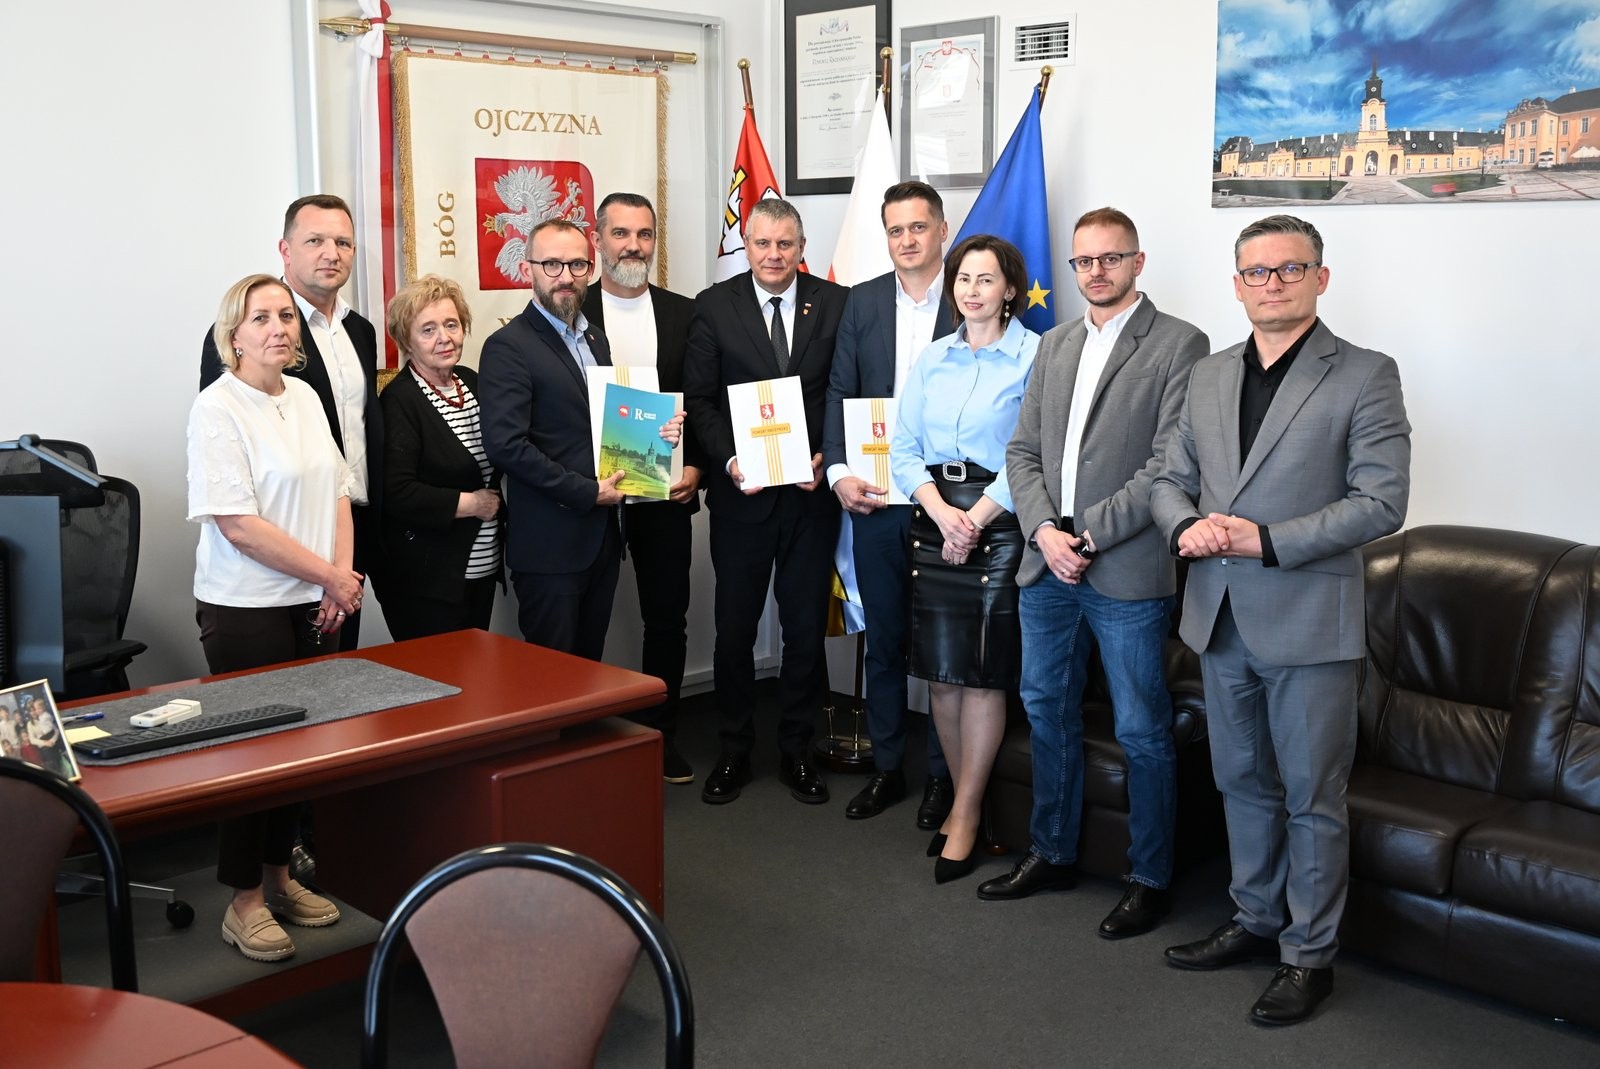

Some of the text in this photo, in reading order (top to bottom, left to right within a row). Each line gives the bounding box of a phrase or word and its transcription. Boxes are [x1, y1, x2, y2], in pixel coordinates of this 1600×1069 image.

[474, 108, 602, 137] OJCZYZNA
[433, 191, 456, 259] BÓG
[635, 408, 644, 421] R
